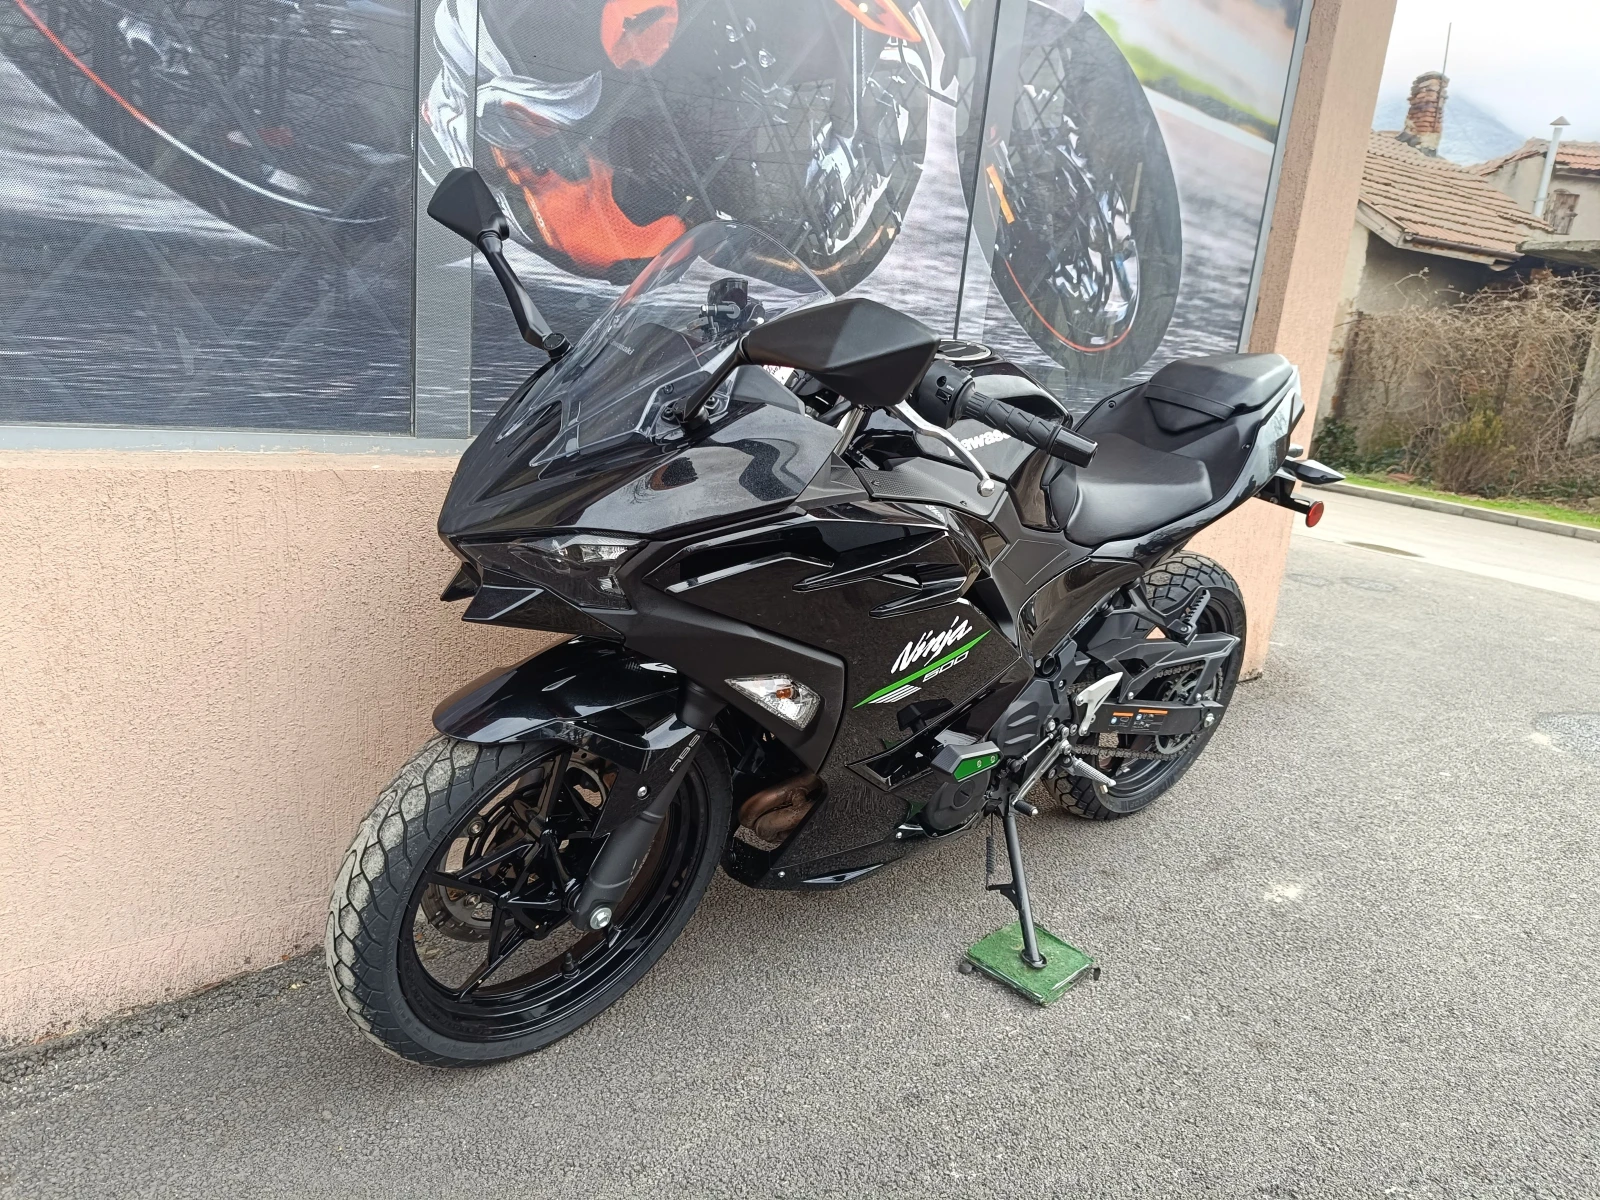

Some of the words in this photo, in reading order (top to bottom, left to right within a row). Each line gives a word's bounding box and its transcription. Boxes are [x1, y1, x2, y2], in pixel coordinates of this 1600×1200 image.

[890, 615, 973, 675] Ninja
[922, 650, 970, 683] 500
[669, 733, 701, 773] ABS
